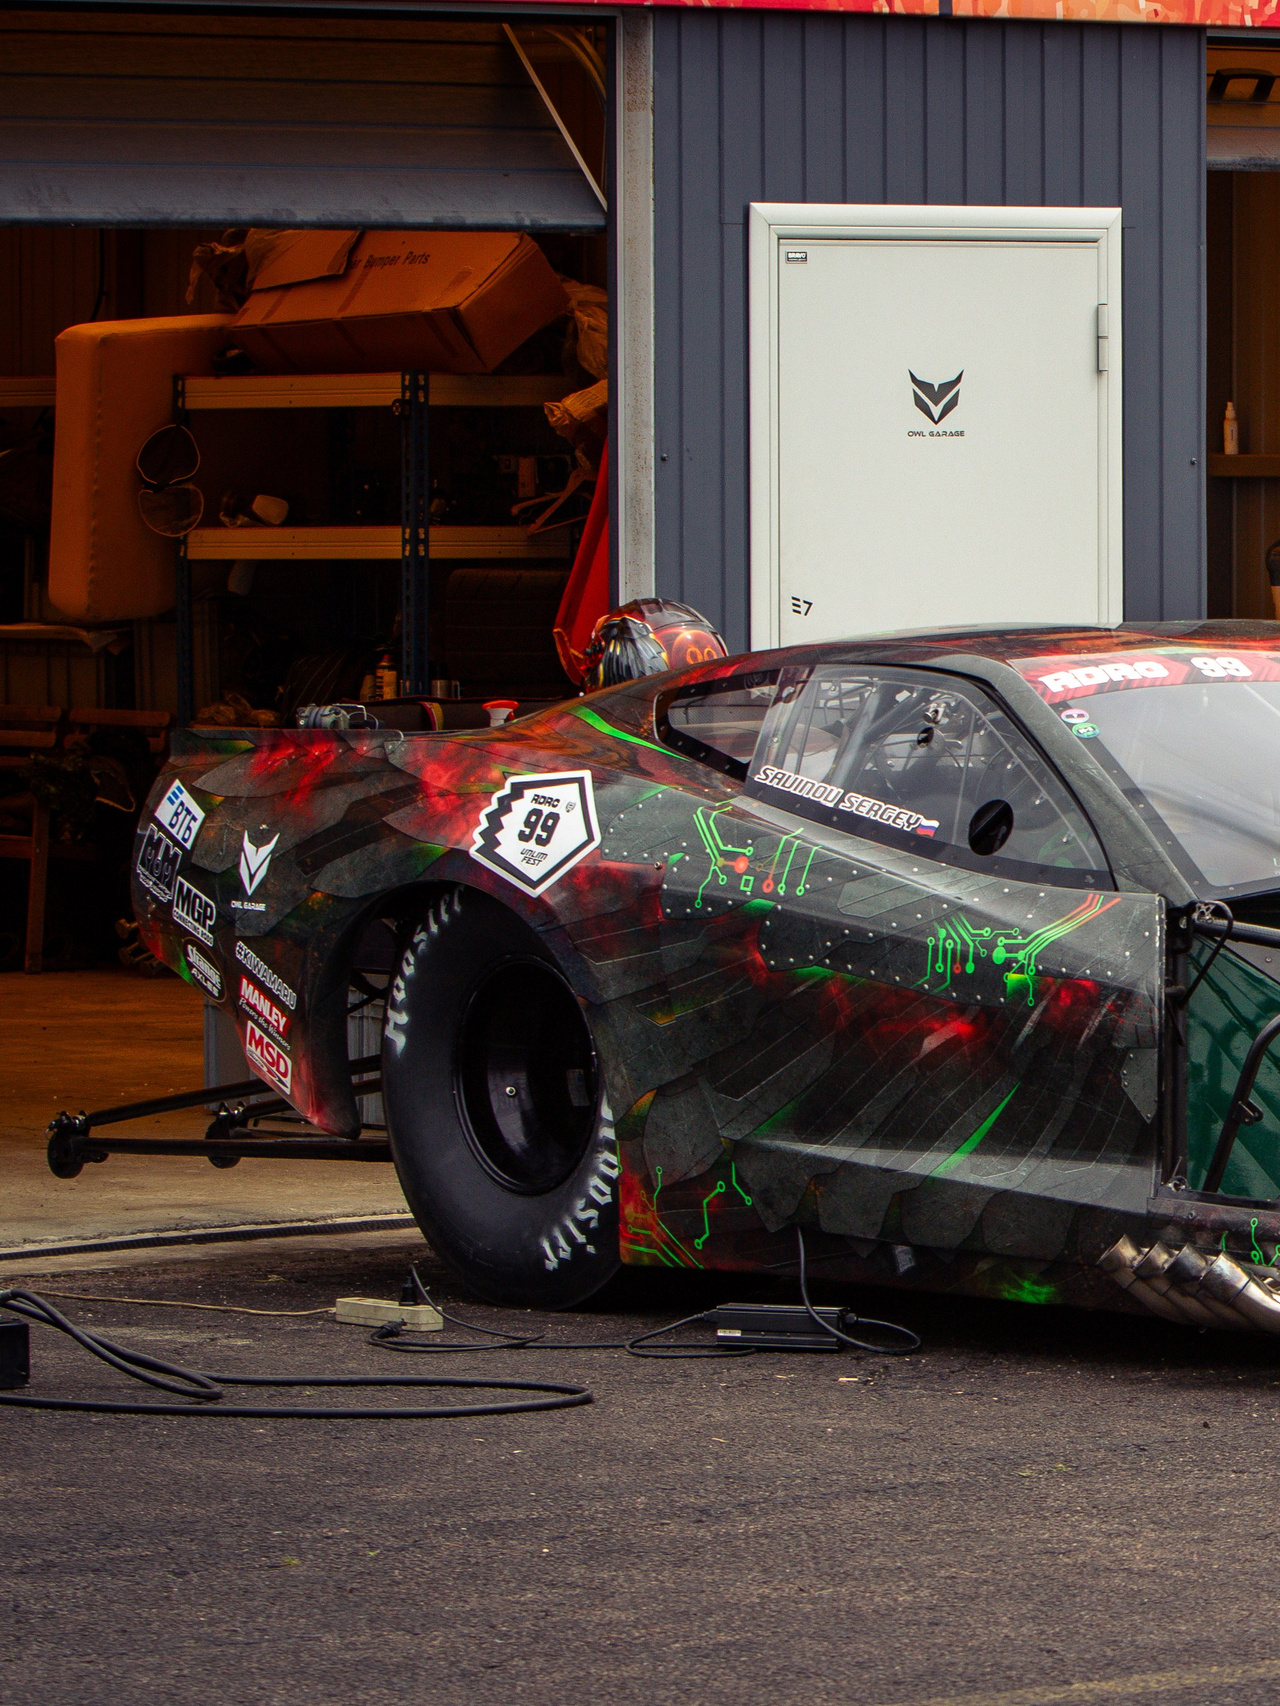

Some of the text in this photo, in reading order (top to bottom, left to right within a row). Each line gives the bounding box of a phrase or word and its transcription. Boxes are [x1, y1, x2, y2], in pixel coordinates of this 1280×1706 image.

[363, 254, 401, 270] Bumper
[402, 251, 430, 265] Parts
[1190, 657, 1252, 677] 99
[531, 794, 560, 808] RDRC
[840, 793, 923, 831] SERGEY
[168, 800, 198, 844] ВТБ
[518, 808, 560, 847] 99
[521, 857, 542, 866] FEST
[175, 879, 214, 930] MGP
[191, 967, 219, 998] AXLES
[235, 941, 297, 1010] #KIWAMARU
[239, 998, 291, 1051] Powers the Winners
[241, 977, 287, 1033] MANLEY
[248, 1024, 289, 1079] MSD
